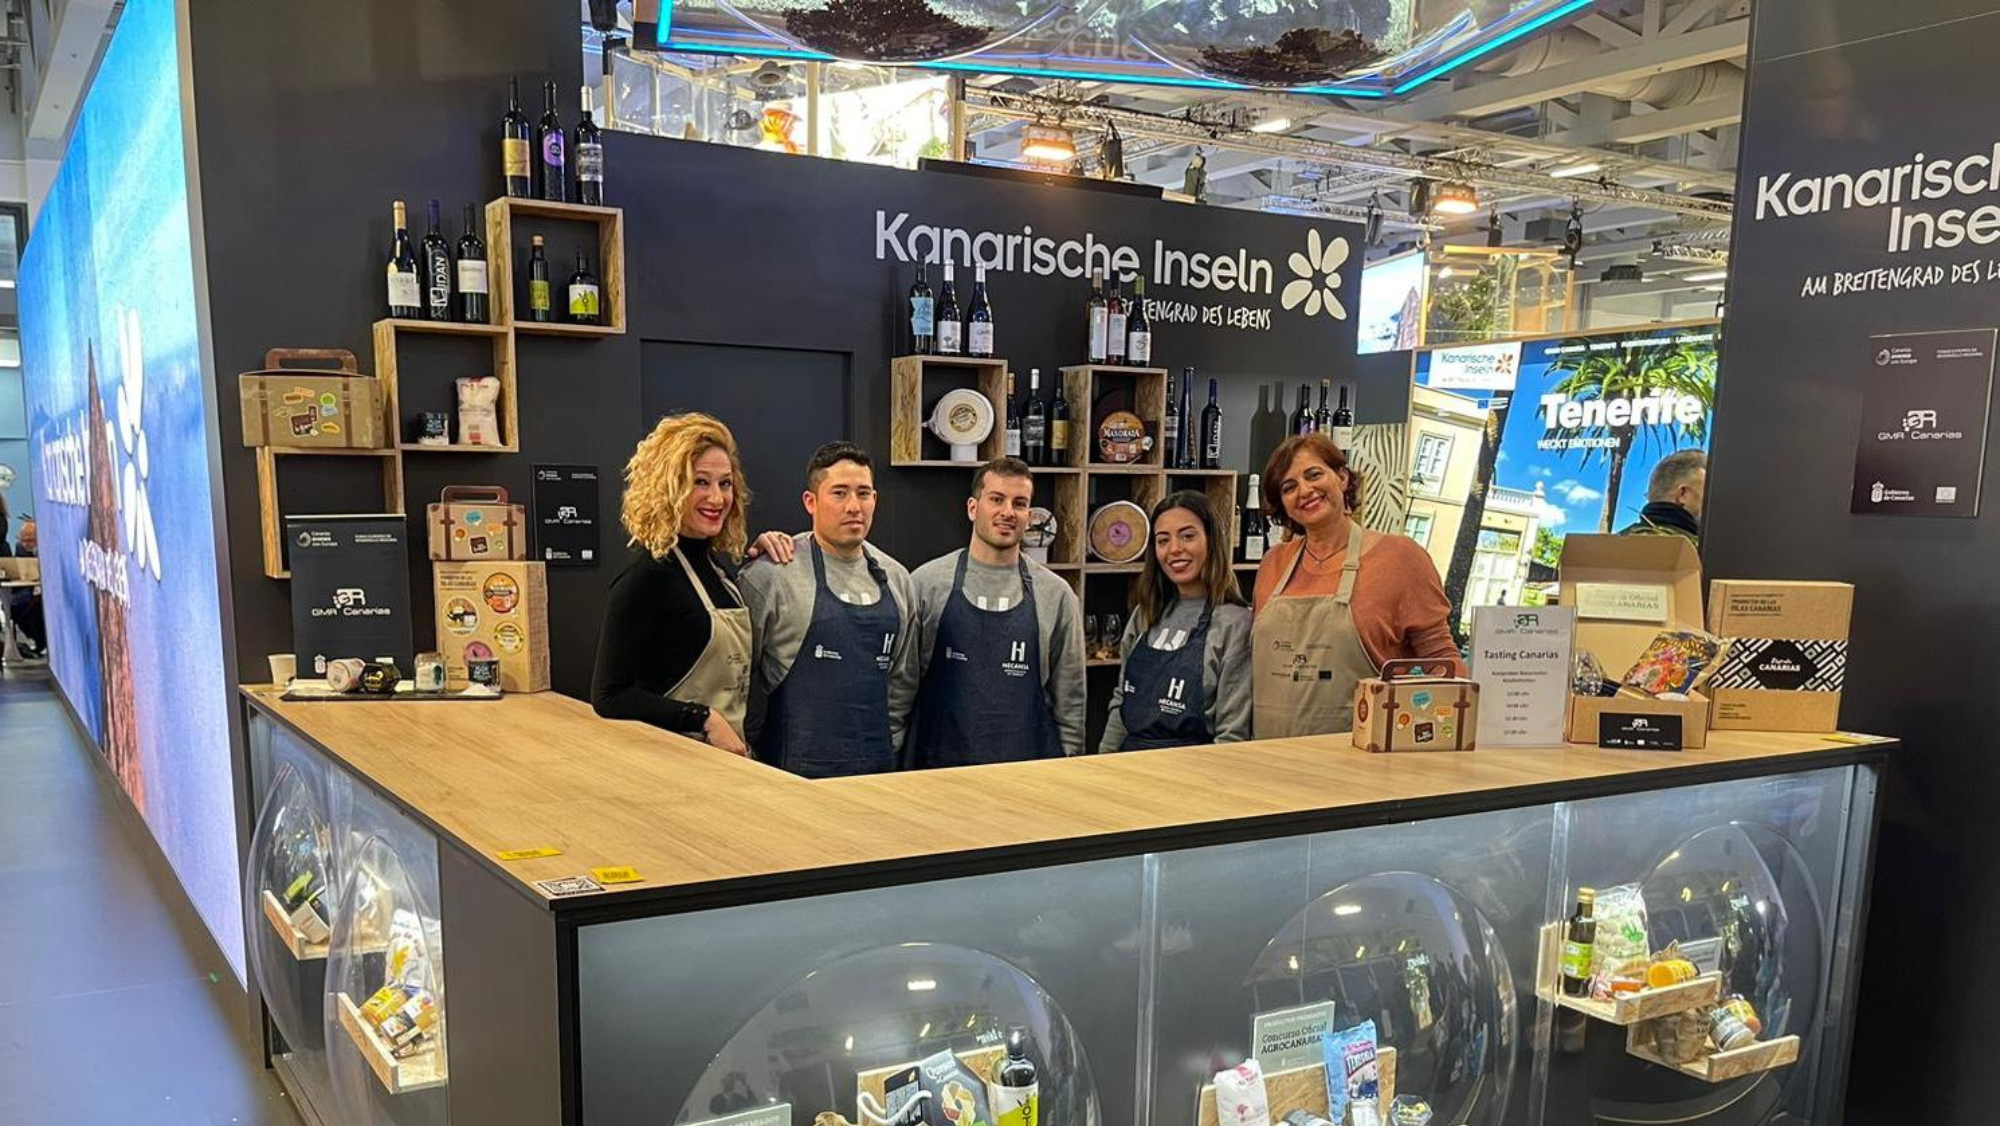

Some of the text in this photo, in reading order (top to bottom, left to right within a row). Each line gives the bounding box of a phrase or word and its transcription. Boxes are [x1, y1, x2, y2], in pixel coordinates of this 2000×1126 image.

[875, 210, 1273, 294] Kanarische Inseln
[1801, 276, 1827, 297] AM
[1833, 266, 1944, 296] BREITENGRAD
[1951, 259, 1981, 283] DES
[1122, 298, 1272, 330] TENGRAD DES LEBENS
[1442, 352, 1495, 363] Kanarische
[1541, 387, 1702, 430] Tenerife
[1878, 431, 1962, 440] GMR Canarias
[1537, 437, 1621, 450] WECKT EMOTIONEN
[312, 607, 391, 617] GMR Canarias
[1484, 650, 1559, 660] Tasting Canarias
[1759, 663, 1800, 671] CANARIAS
[1262, 1022, 1327, 1044] Concurso Oficial
